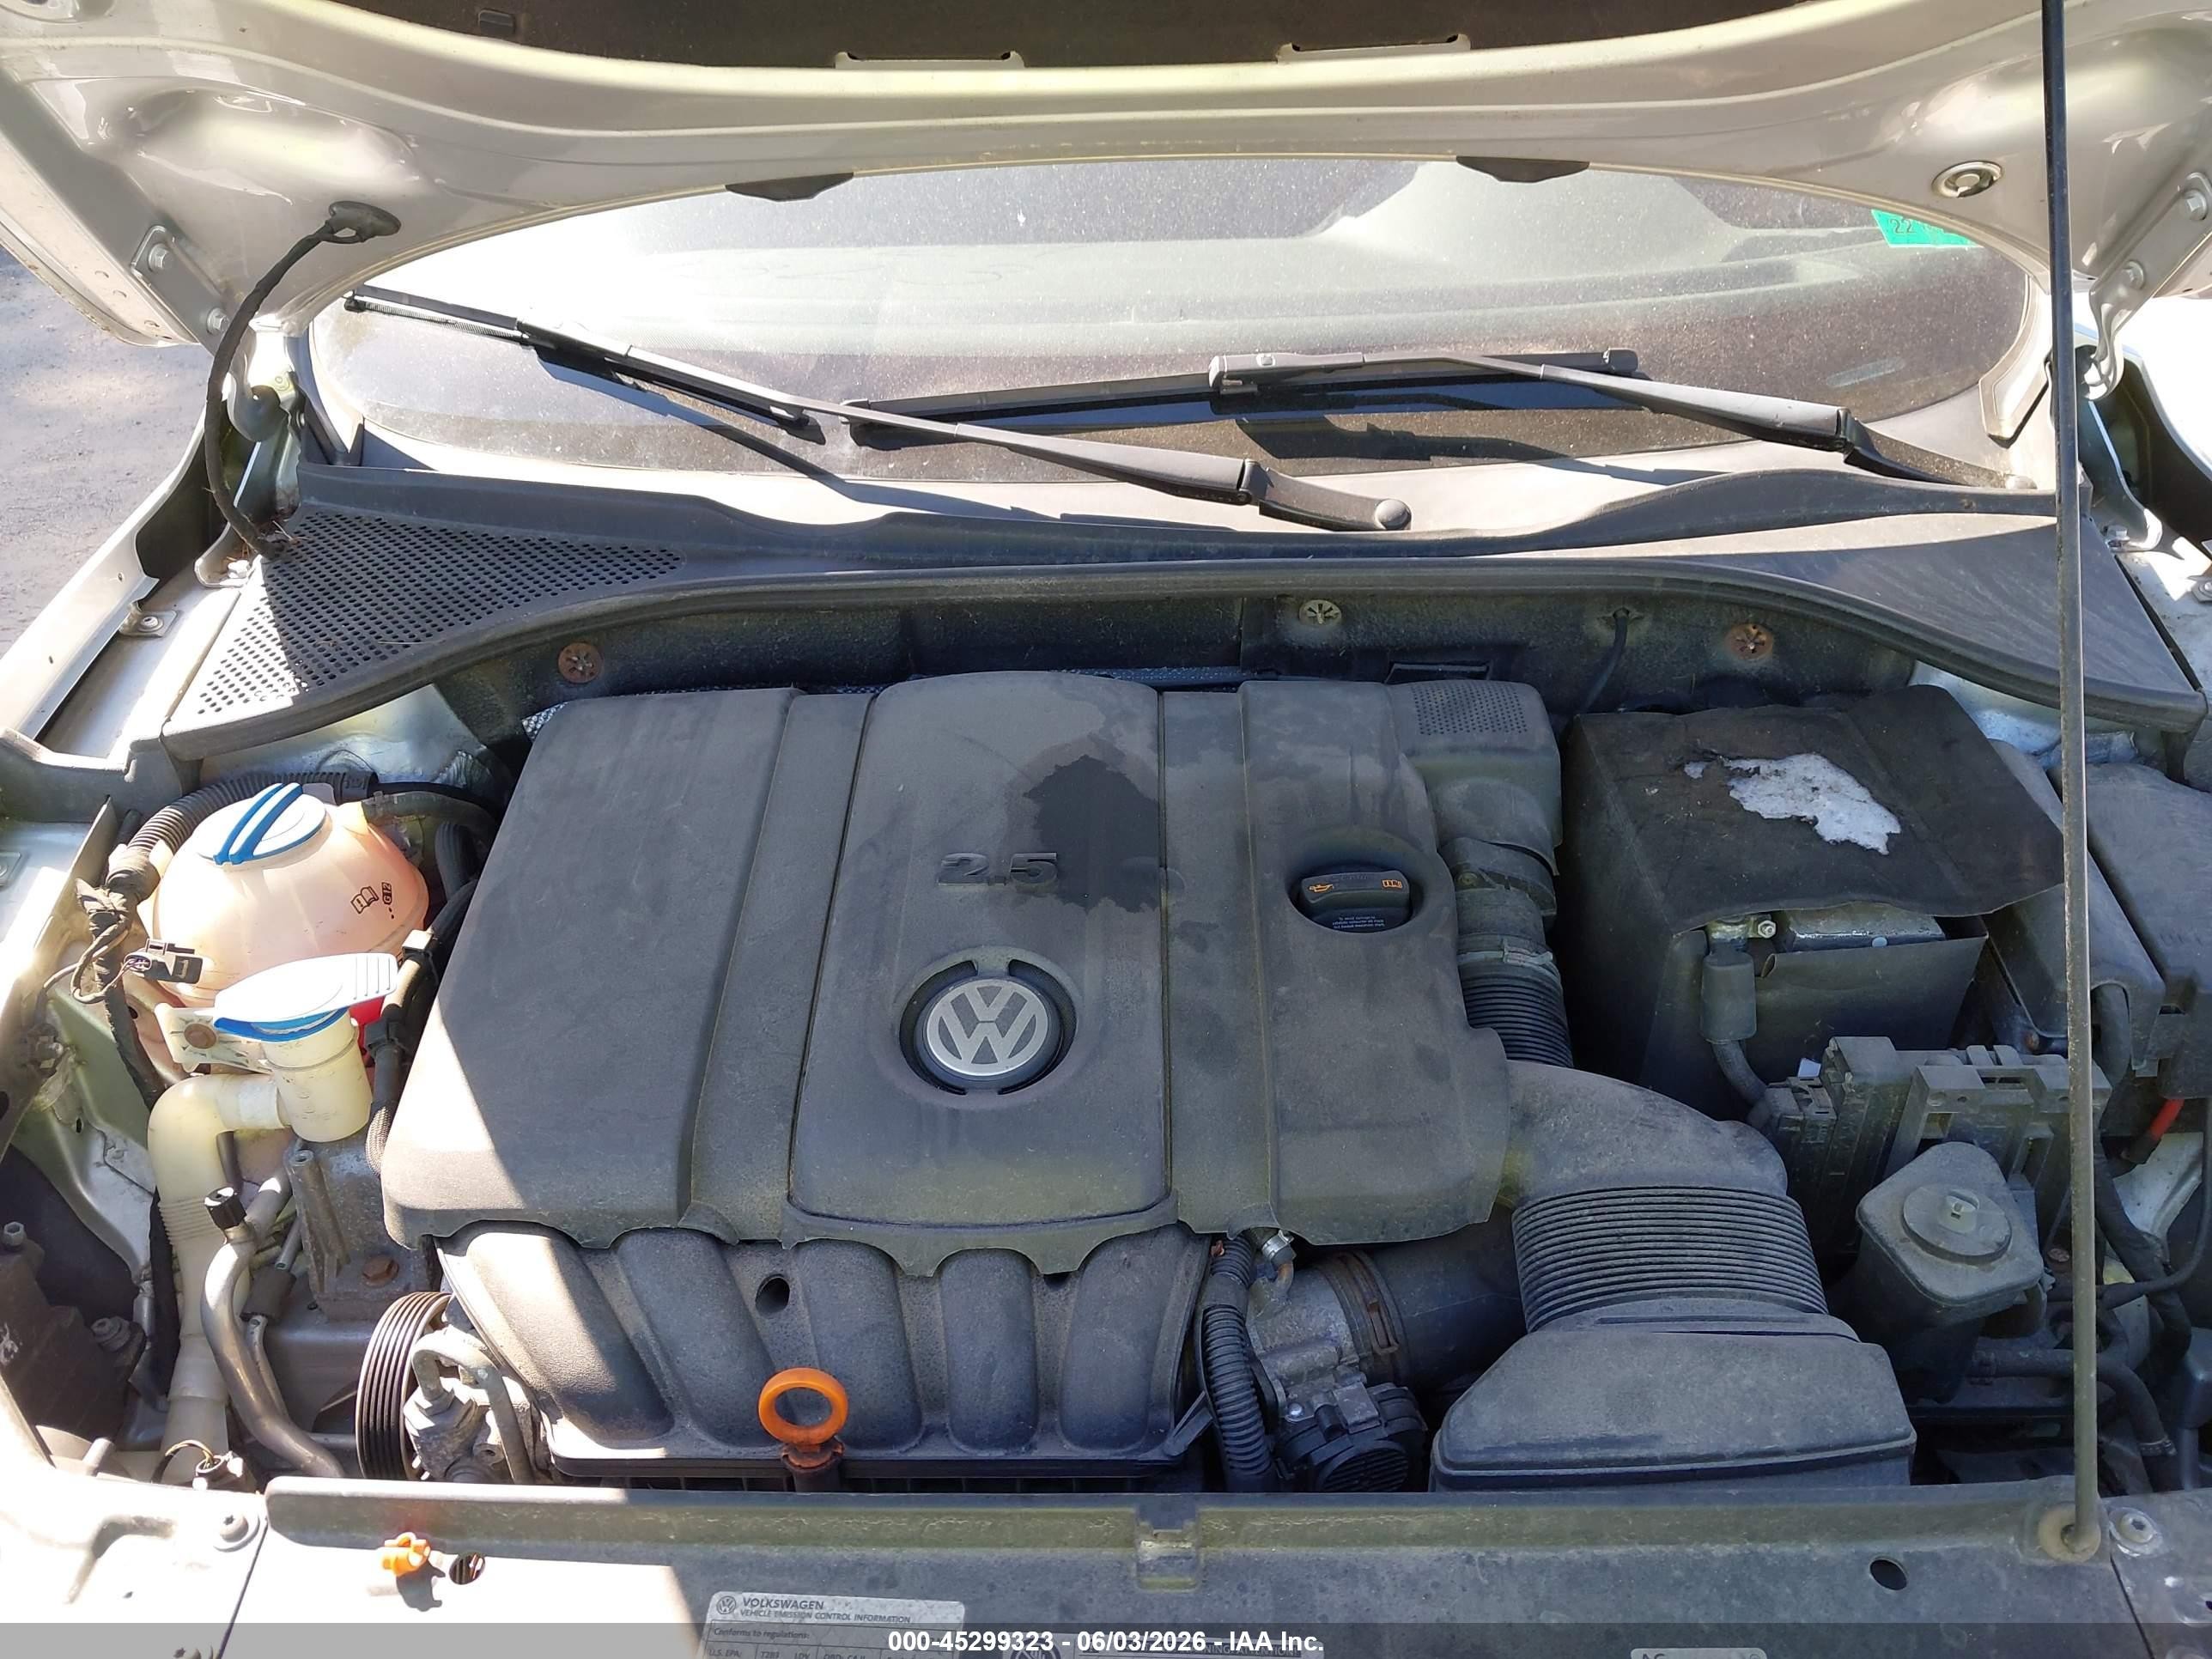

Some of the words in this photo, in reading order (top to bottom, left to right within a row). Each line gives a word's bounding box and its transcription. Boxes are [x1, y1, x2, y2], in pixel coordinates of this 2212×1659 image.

[939, 853, 1058, 885] 2.5
[743, 1597, 824, 1610] VOLKSWAGEN
[740, 1608, 771, 1618] VEHICLE
[814, 1612, 851, 1621] CONTROL
[854, 1613, 910, 1623] INFORMATION
[714, 1627, 750, 1637] Conforms
